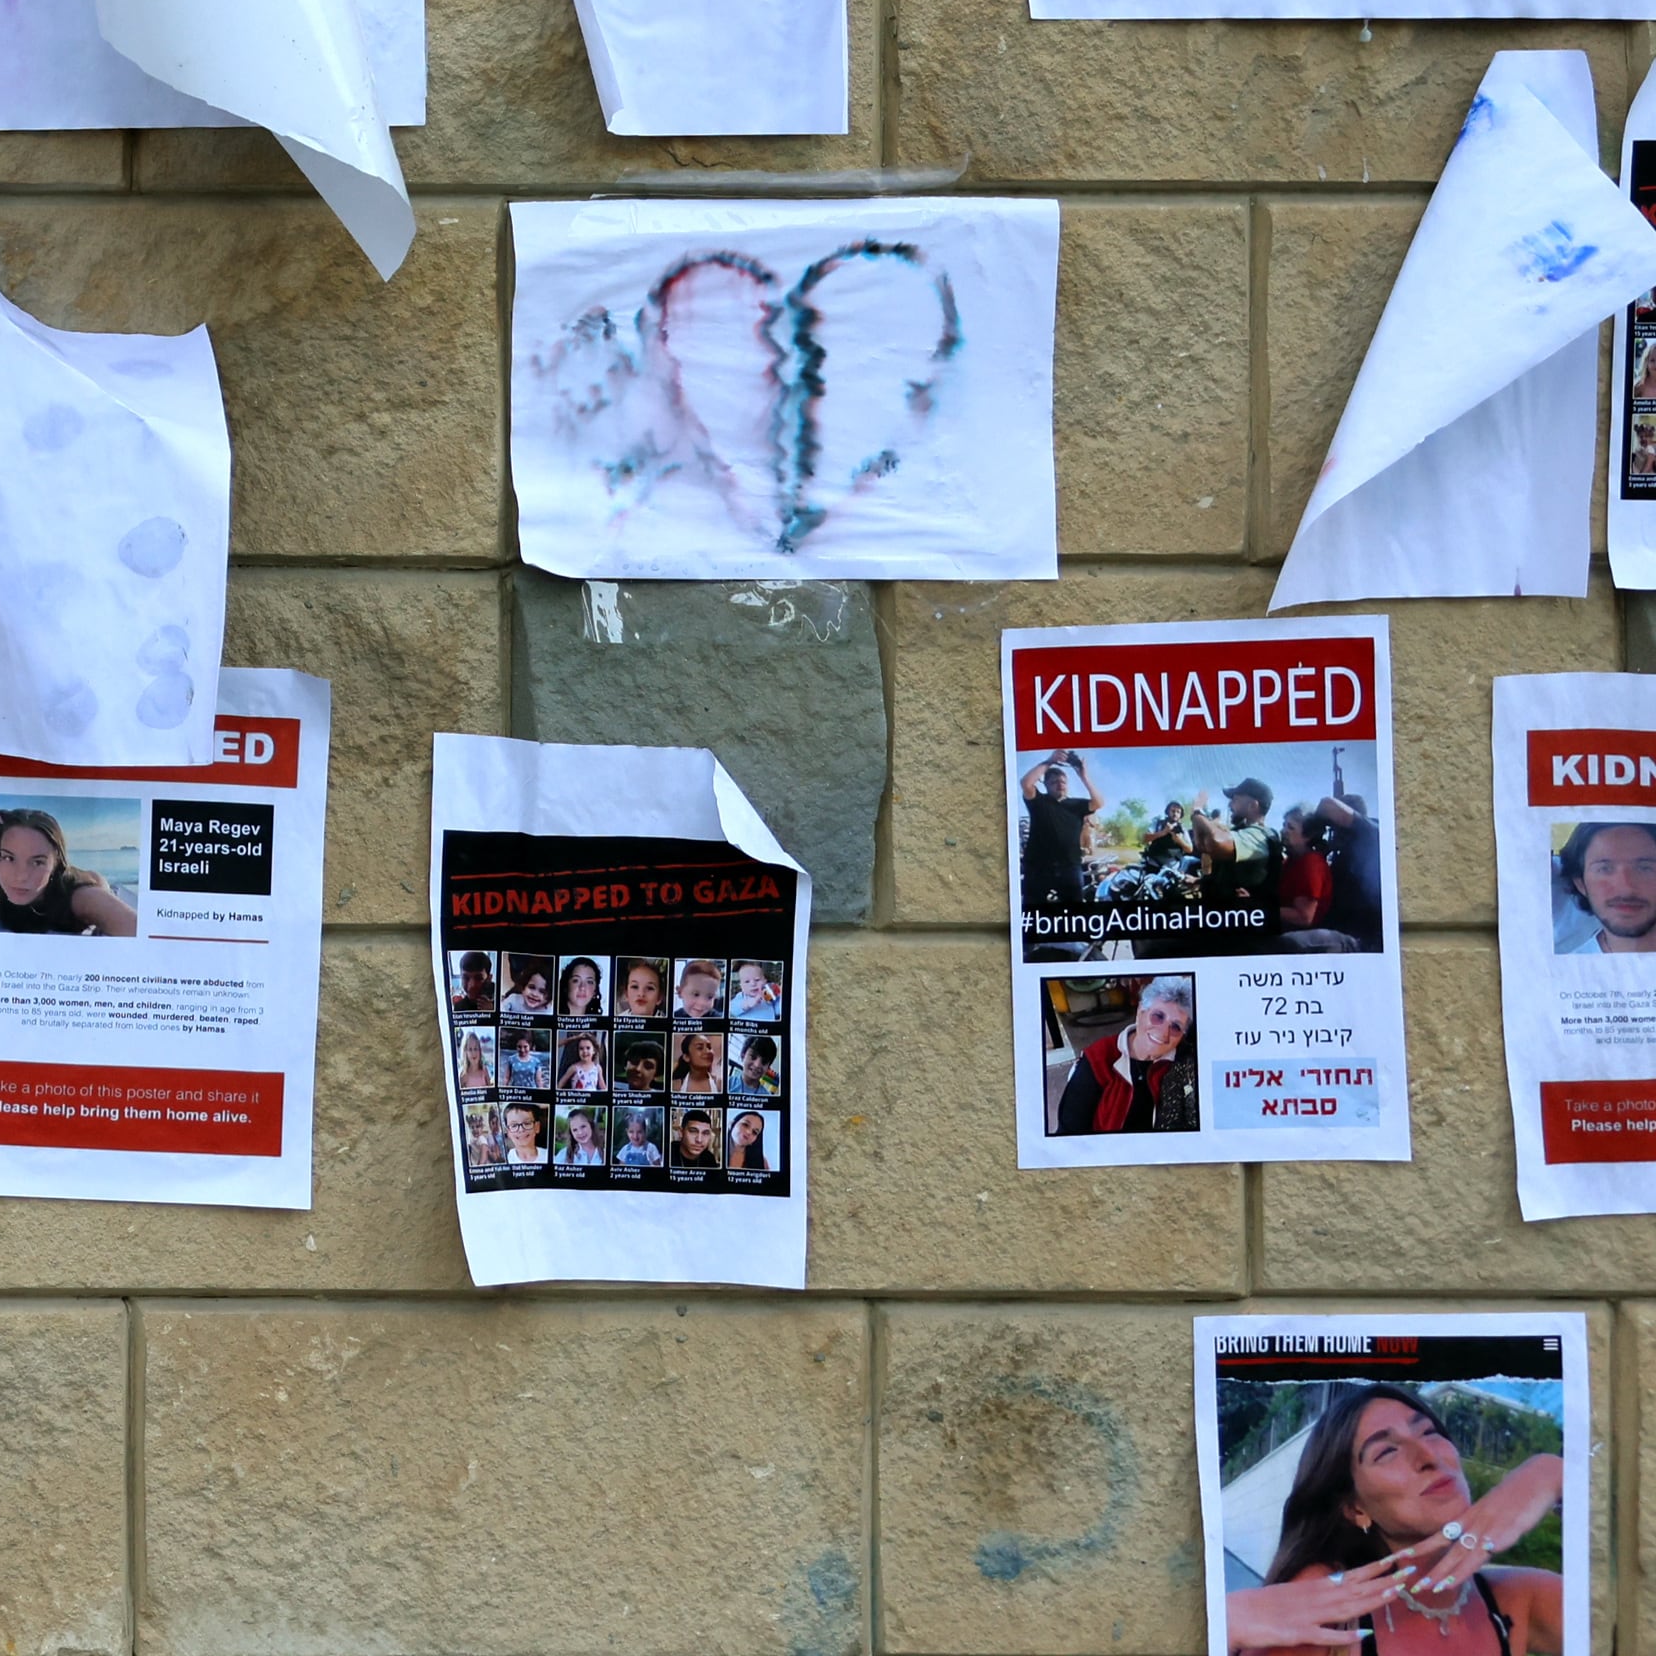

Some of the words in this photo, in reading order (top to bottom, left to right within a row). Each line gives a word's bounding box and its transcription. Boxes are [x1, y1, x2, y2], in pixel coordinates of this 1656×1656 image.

[1033, 665, 1363, 735] KIDNAPPED
[160, 818, 203, 836] Maya
[209, 820, 260, 838] Regev
[159, 838, 262, 857] 21-years-old
[159, 858, 209, 874] Israeli
[452, 883, 630, 916] KIDNAPPED
[640, 882, 681, 904] TO
[693, 875, 780, 902] GAZA
[1021, 906, 1265, 939] #bringAdinaHome
[1239, 973, 1283, 987] משה
[1292, 971, 1344, 986] עדינה
[1261, 997, 1287, 1015] 72
[1295, 1000, 1324, 1014] בת
[1235, 1031, 1261, 1046] עוז
[1269, 1030, 1295, 1044] ניר
[1303, 1029, 1352, 1048] קיבוץ
[1225, 1068, 1283, 1088] אלינו
[1300, 1068, 1373, 1086] תחזרי
[1262, 1098, 1337, 1116] סבתא
[1571, 1119, 1622, 1133] Please
